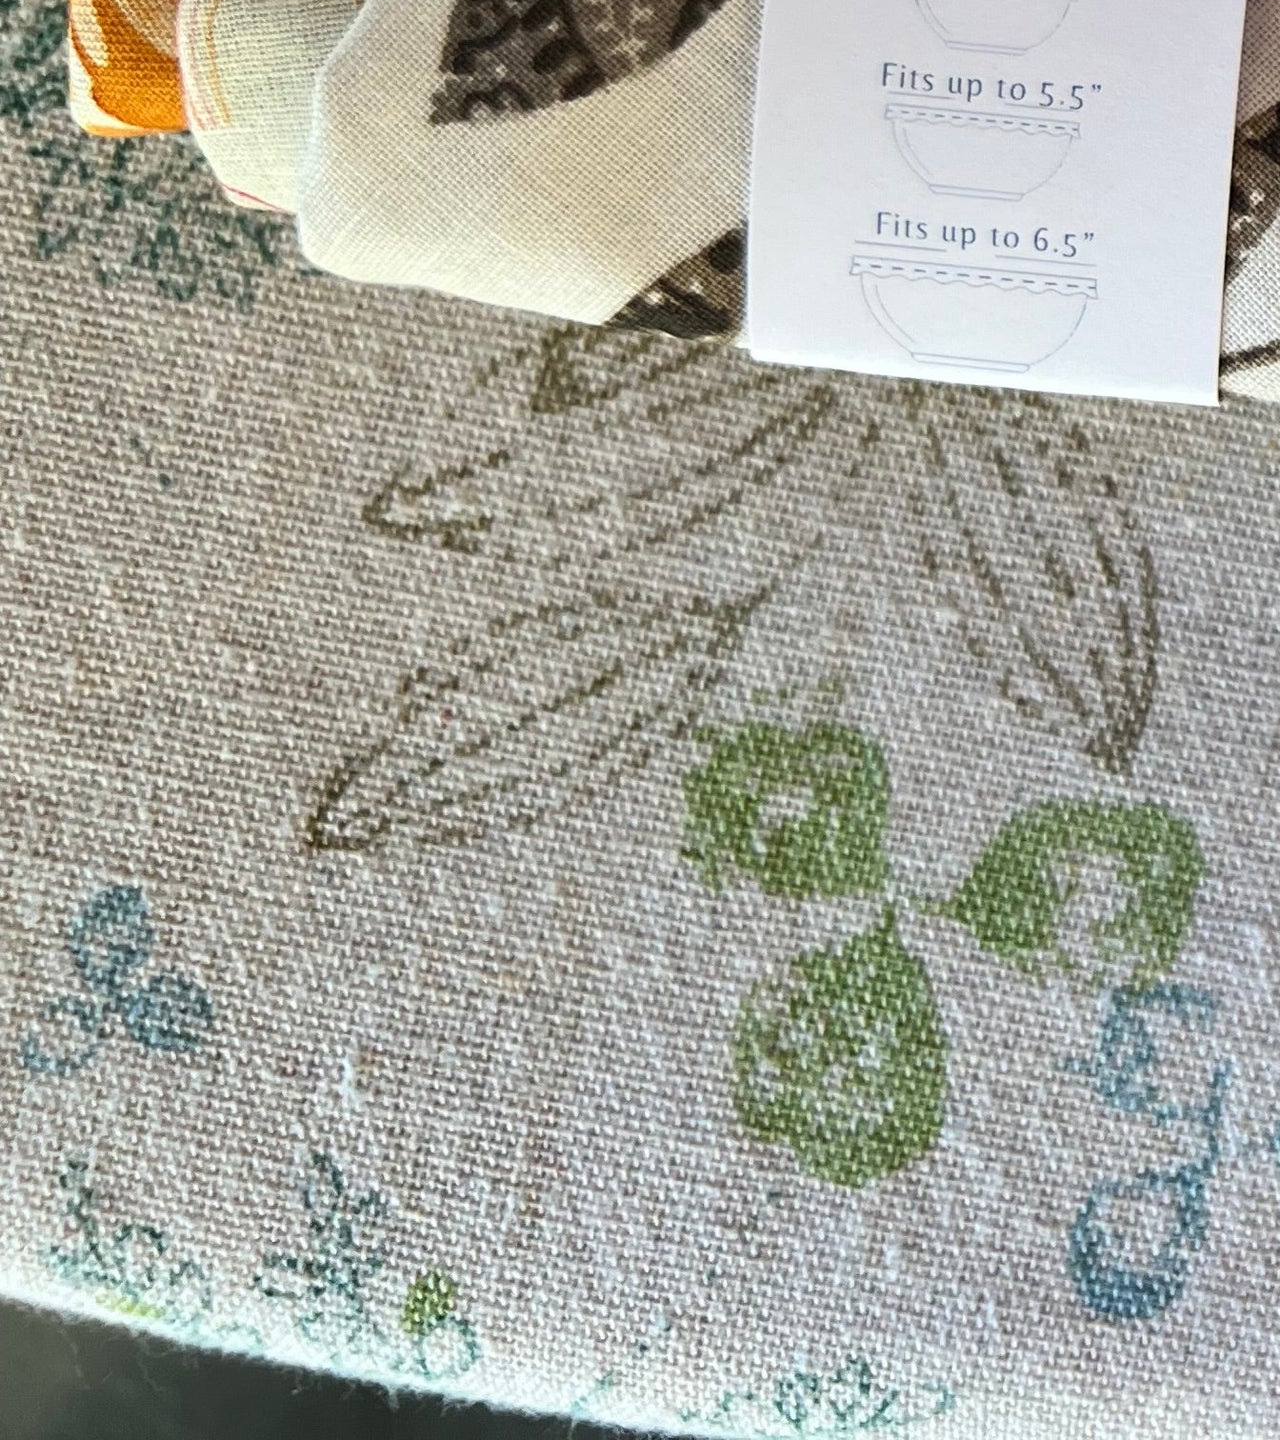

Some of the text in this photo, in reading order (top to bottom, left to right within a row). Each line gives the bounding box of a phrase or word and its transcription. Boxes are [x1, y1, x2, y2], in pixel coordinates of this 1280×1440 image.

[881, 62, 934, 92] Fits
[948, 74, 982, 100] up
[998, 79, 1026, 102] to
[876, 211, 928, 240] Fits
[942, 224, 976, 249] up
[992, 228, 1020, 250] to
